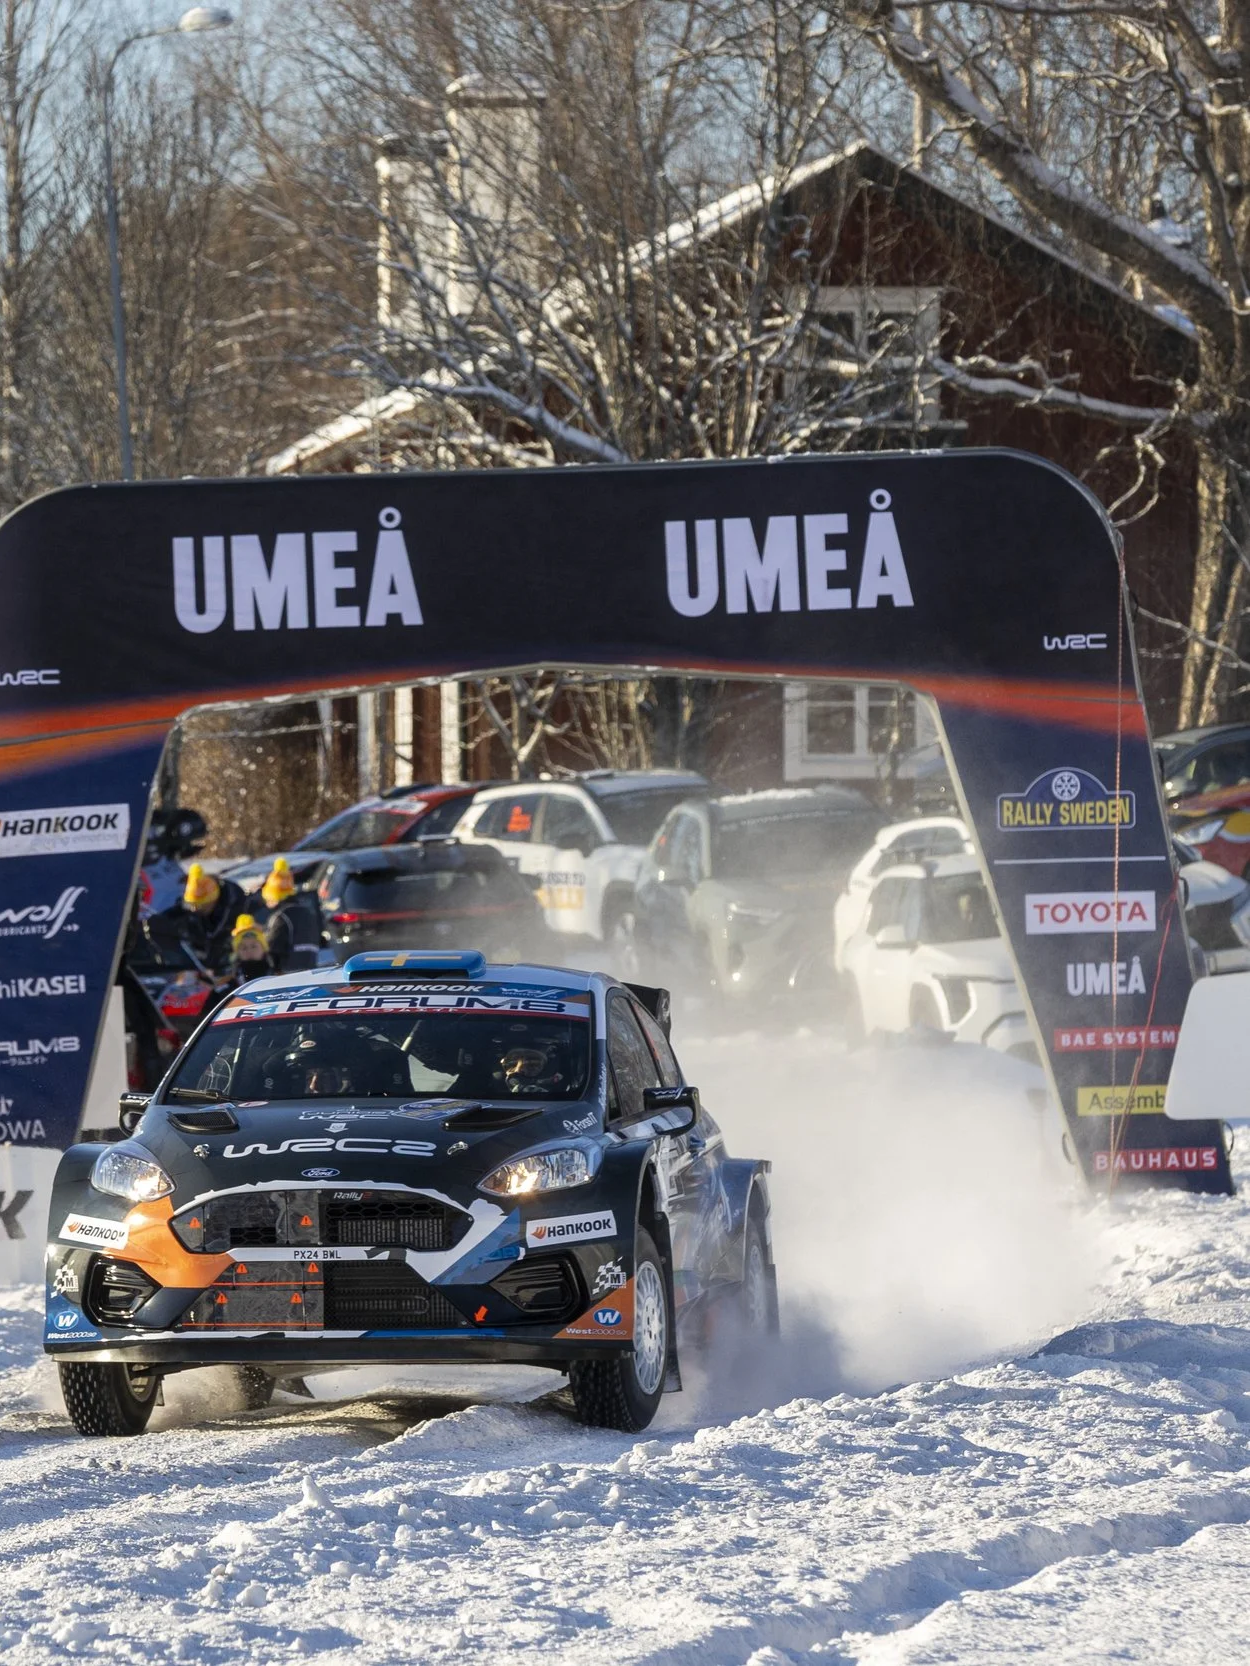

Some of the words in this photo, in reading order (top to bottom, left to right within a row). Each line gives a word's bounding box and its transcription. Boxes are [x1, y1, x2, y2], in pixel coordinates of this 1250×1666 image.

[664, 488, 915, 618] UMEÅ
[172, 506, 424, 634] UMEÅ
[1043, 633, 1108, 651] WRC
[1003, 800, 1054, 826] RALLY
[1059, 797, 1130, 825] SWEDEN
[1033, 901, 1148, 925] TOYOTA
[1066, 955, 1146, 997] UMEÅ
[287, 996, 566, 1013] FORUM8
[1061, 1032, 1096, 1047] BAE
[1103, 1030, 1180, 1046] SYSTEM
[222, 1138, 437, 1159] WRC2
[1095, 1149, 1217, 1170] BAUHAUS
[307, 1168, 334, 1177] Ford
[333, 1191, 373, 1201] Rally2
[293, 1250, 318, 1260] PX24
[323, 1250, 342, 1260] BWL
[58, 1314, 78, 1327] W
[597, 1311, 620, 1324] W
